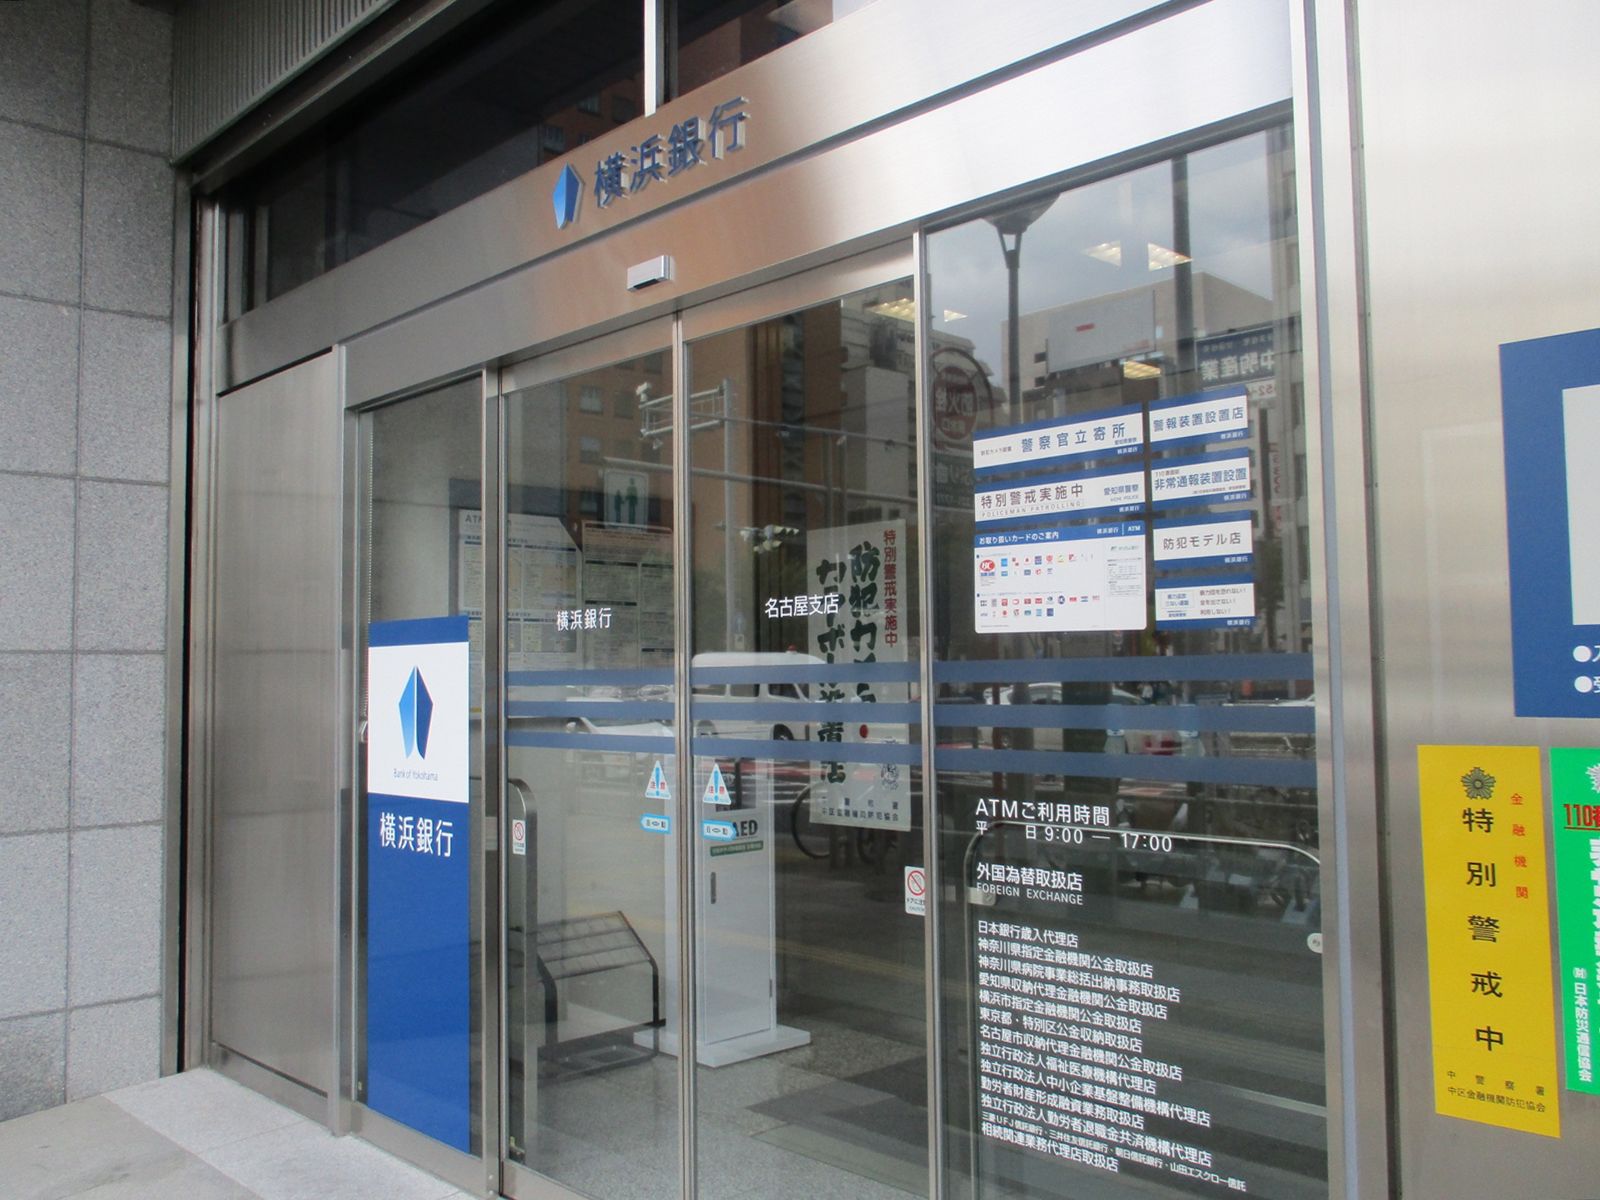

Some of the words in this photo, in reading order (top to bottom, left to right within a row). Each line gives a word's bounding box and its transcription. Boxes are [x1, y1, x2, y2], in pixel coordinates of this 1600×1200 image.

[594, 96, 750, 208] 横浜銀行
[1153, 406, 1244, 432] 警報装置設置店
[1021, 422, 1125, 453] 警察官立寄所
[1154, 467, 1248, 490] 非常通報装置設置
[980, 483, 1083, 509] 特別警戒実施中
[982, 508, 1026, 518] POLICEMAN
[1030, 501, 1082, 512] PATROLLING
[979, 531, 1059, 545] お取り扱いカードのご案内
[1163, 532, 1241, 550] 防犯モデル店
[883, 529, 898, 648] 特別警戒実施中
[556, 607, 613, 632] 横浜銀行
[764, 592, 840, 619] 名古屋支店
[975, 798, 1110, 827] ATMご利用時間
[379, 811, 454, 858] 横浜銀行
[1045, 825, 1084, 844] 9:00
[1120, 832, 1172, 852] 17:00
[1510, 792, 1529, 899] 金融機関
[976, 861, 1083, 892] 外国為替取扱店
[976, 882, 1021, 898] FOREIGN
[1026, 888, 1084, 906] EXCHANGE
[978, 920, 1079, 949] 日本銀行歳入代理店
[1461, 807, 1504, 1052] 特別警戒中
[978, 937, 1154, 979] 神奈川県指定金融機関公金取扱店
[978, 954, 1181, 1004] 神奈川県病院事業総括出納事務取扱店
[979, 971, 1168, 1020] 愛知県収納代理金融機関公金取扱店
[979, 989, 1143, 1034] 横浜市指定金融機関公金取扱店
[979, 1024, 1183, 1082] 名古屋市収納代理金融機関公金取扱店
[980, 1041, 1157, 1096] 独立行政法人福祉医療機構代理店
[980, 1059, 1212, 1128] 独立行政法人中小企業基盤整備機構代理店
